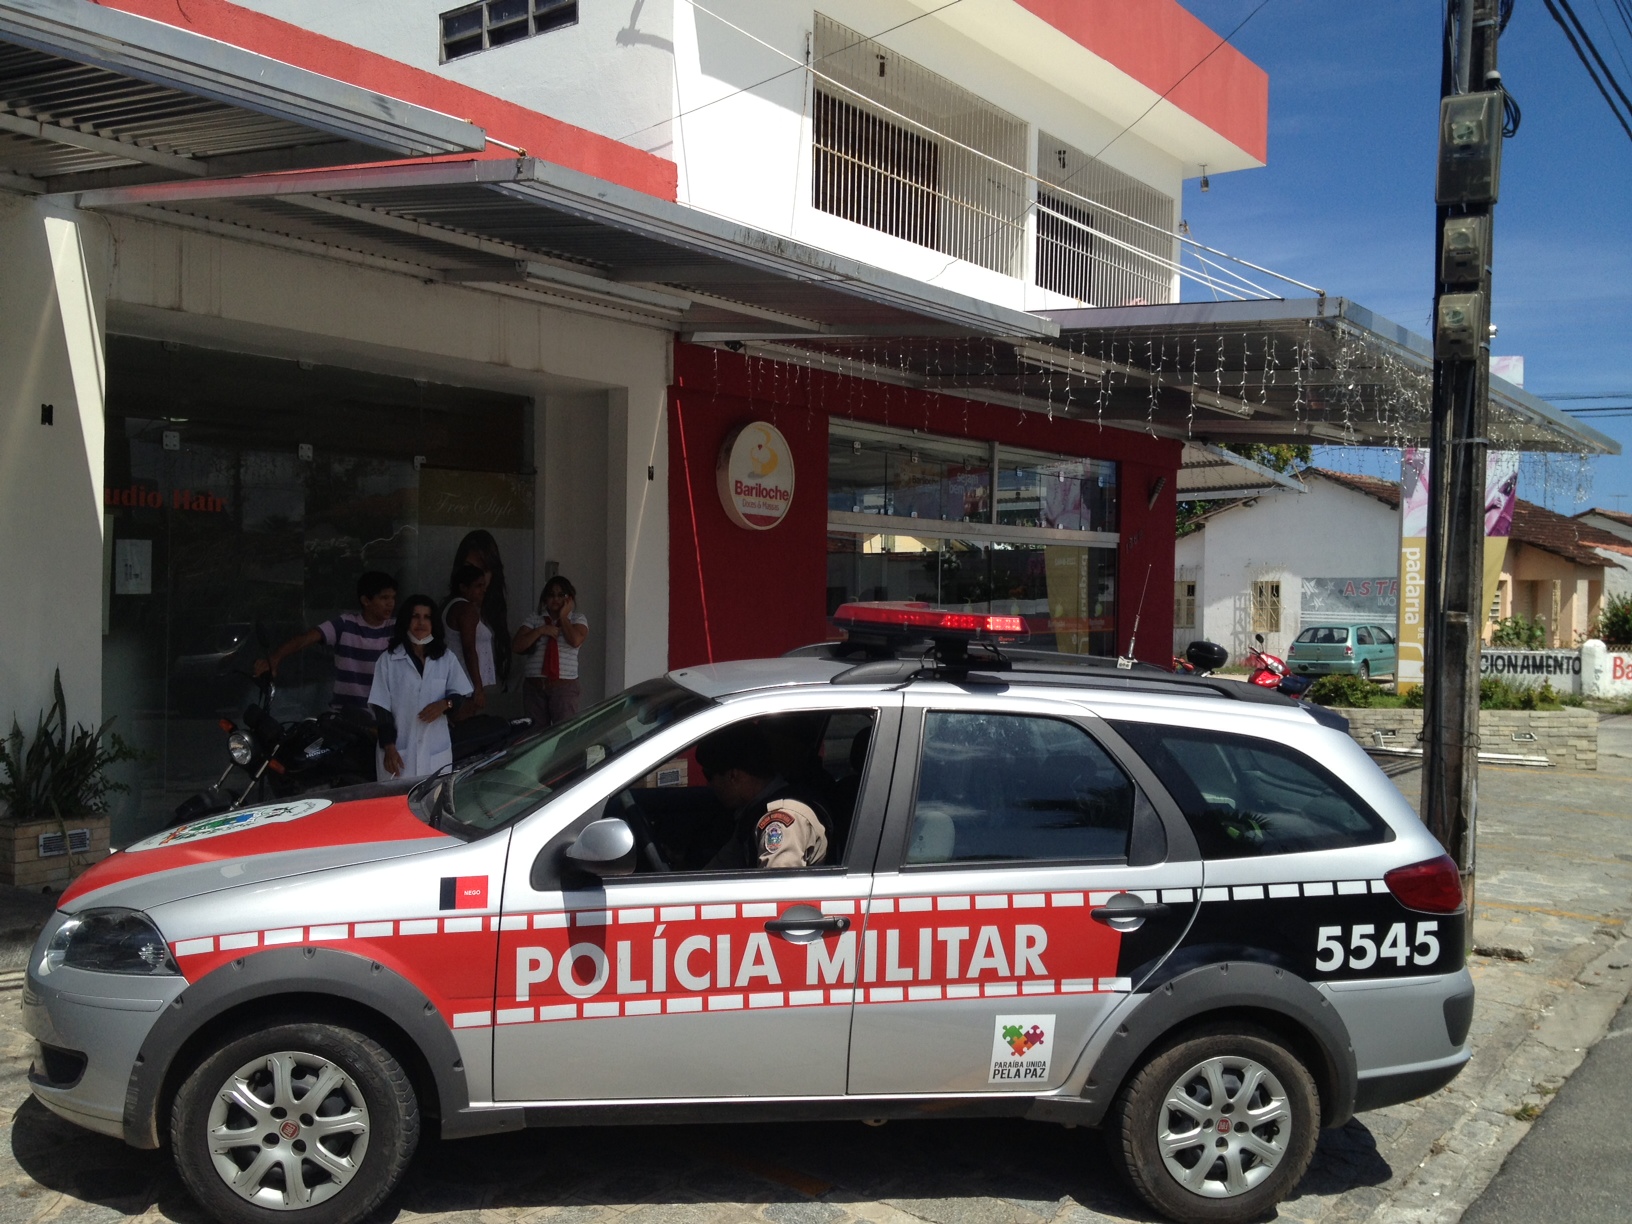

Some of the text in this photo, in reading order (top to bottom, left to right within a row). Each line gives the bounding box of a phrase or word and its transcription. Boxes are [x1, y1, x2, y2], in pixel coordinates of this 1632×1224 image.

[173, 488, 229, 513] Hair
[734, 479, 790, 502] Bariloche
[742, 498, 757, 509] Doces
[762, 501, 780, 511] Massas
[1402, 547, 1424, 625] padaria
[1315, 921, 1441, 972] 5545
[515, 923, 1049, 1003] POLÍCIA MILITAR
[992, 1067, 1046, 1080] PELA PAZ
[994, 1060, 1047, 1069] PARAÍBA UNIDA
